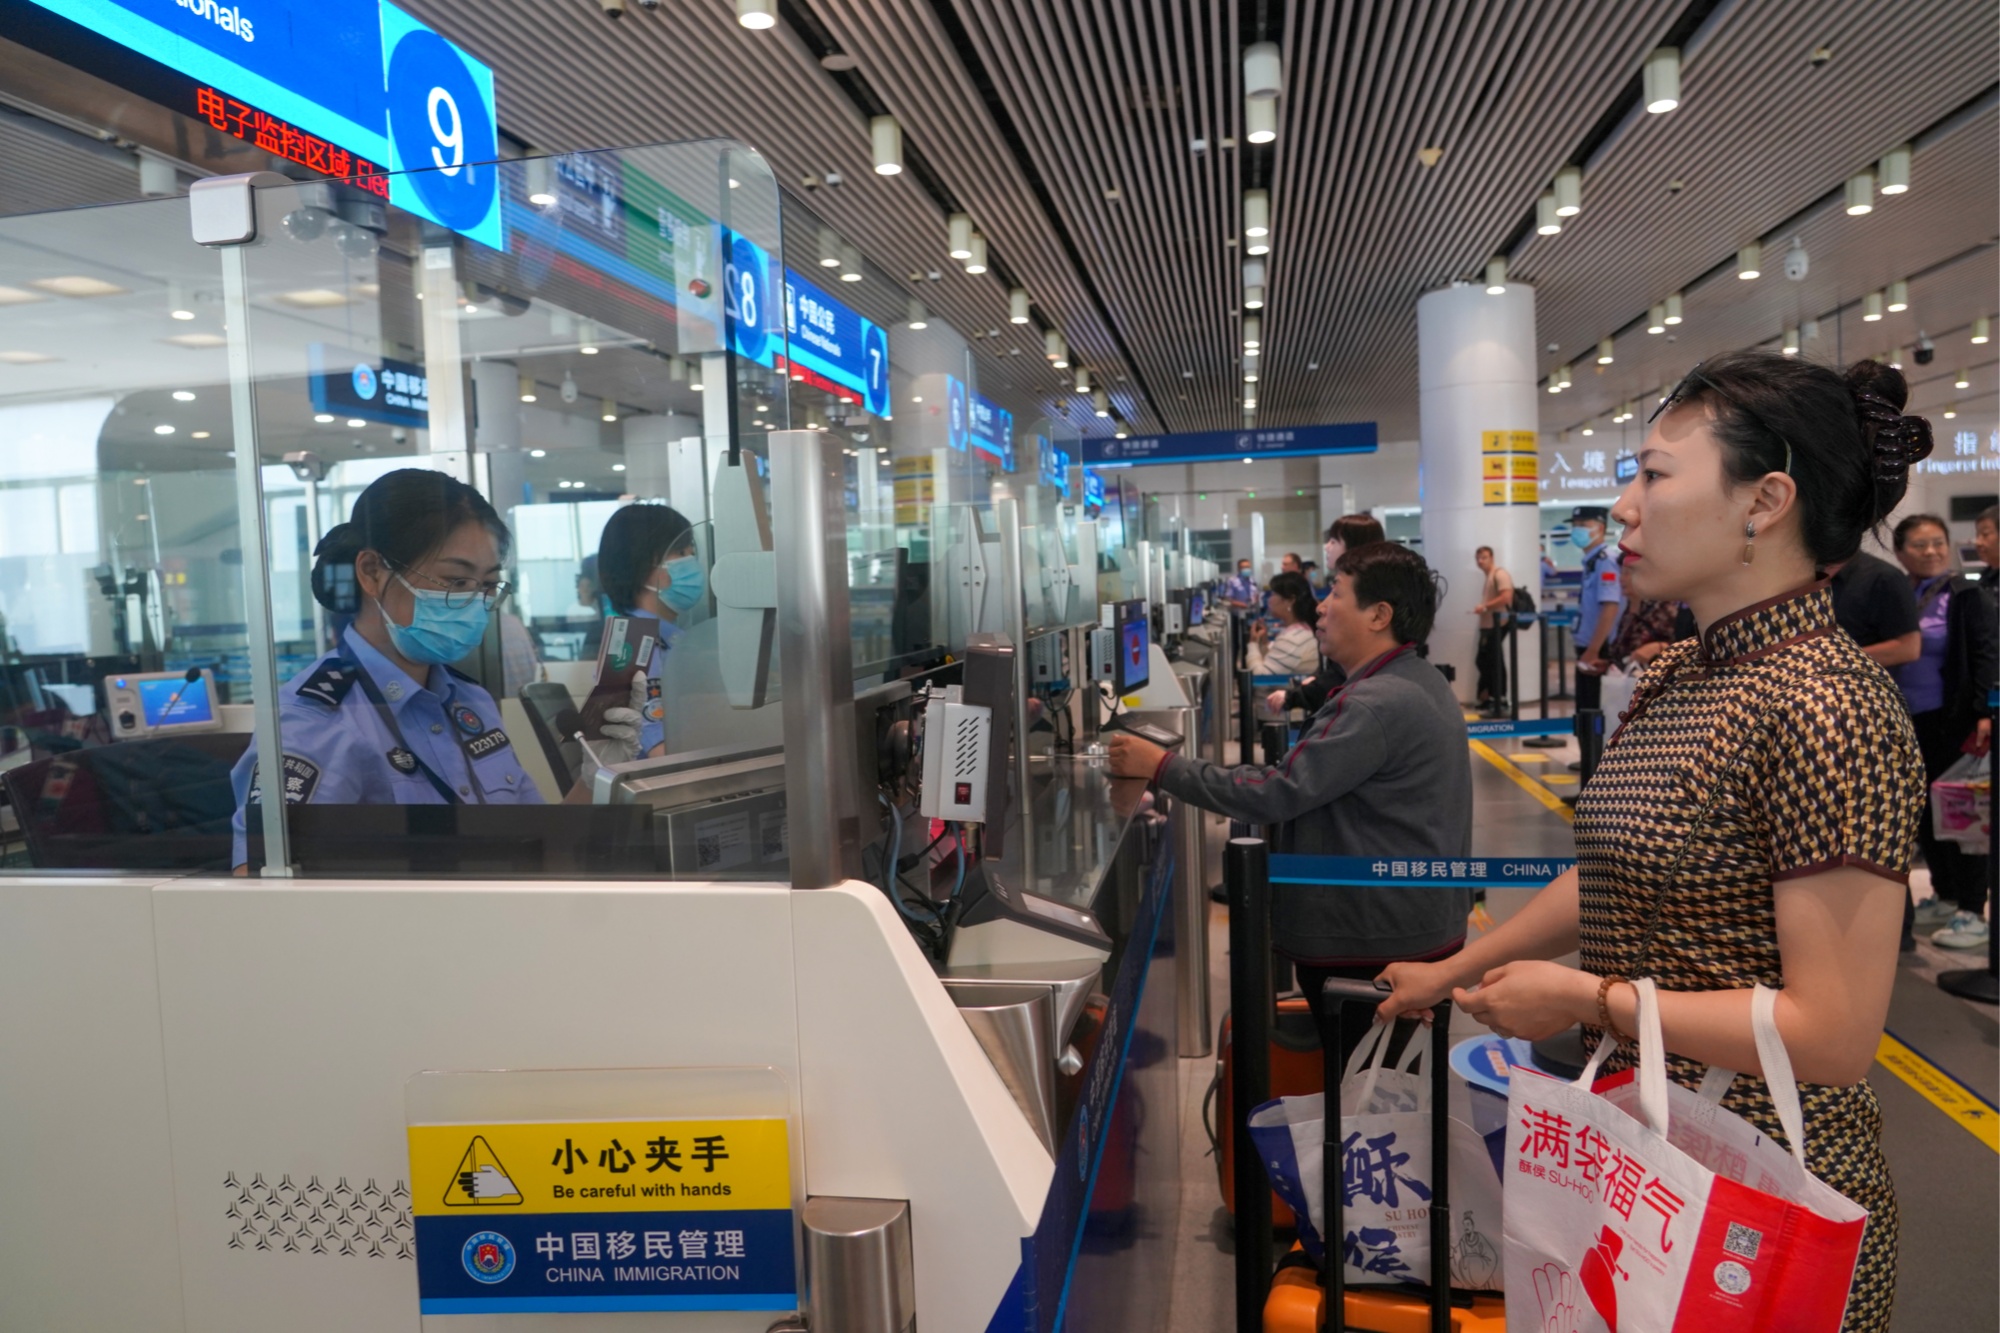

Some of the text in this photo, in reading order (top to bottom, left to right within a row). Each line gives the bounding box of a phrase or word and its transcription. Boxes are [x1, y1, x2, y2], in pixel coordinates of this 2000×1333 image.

[176, 0, 255, 42] onals
[197, 88, 351, 185] 电子监控区域
[427, 86, 464, 177] 9
[741, 271, 757, 328] 8
[870, 348, 881, 390] 7
[469, 731, 507, 755] 123179
[1372, 861, 1488, 877] 中国移民管理
[1503, 864, 1551, 876] CHINA
[551, 1135, 730, 1175] 小心夹手
[553, 1183, 732, 1198] Be careful with hands
[1519, 1104, 1685, 1253] 满袋福气
[1384, 1207, 1430, 1221] SU HO
[536, 1230, 746, 1261] 中国移民管理
[546, 1266, 740, 1282] CHINA IMMIGRATION
